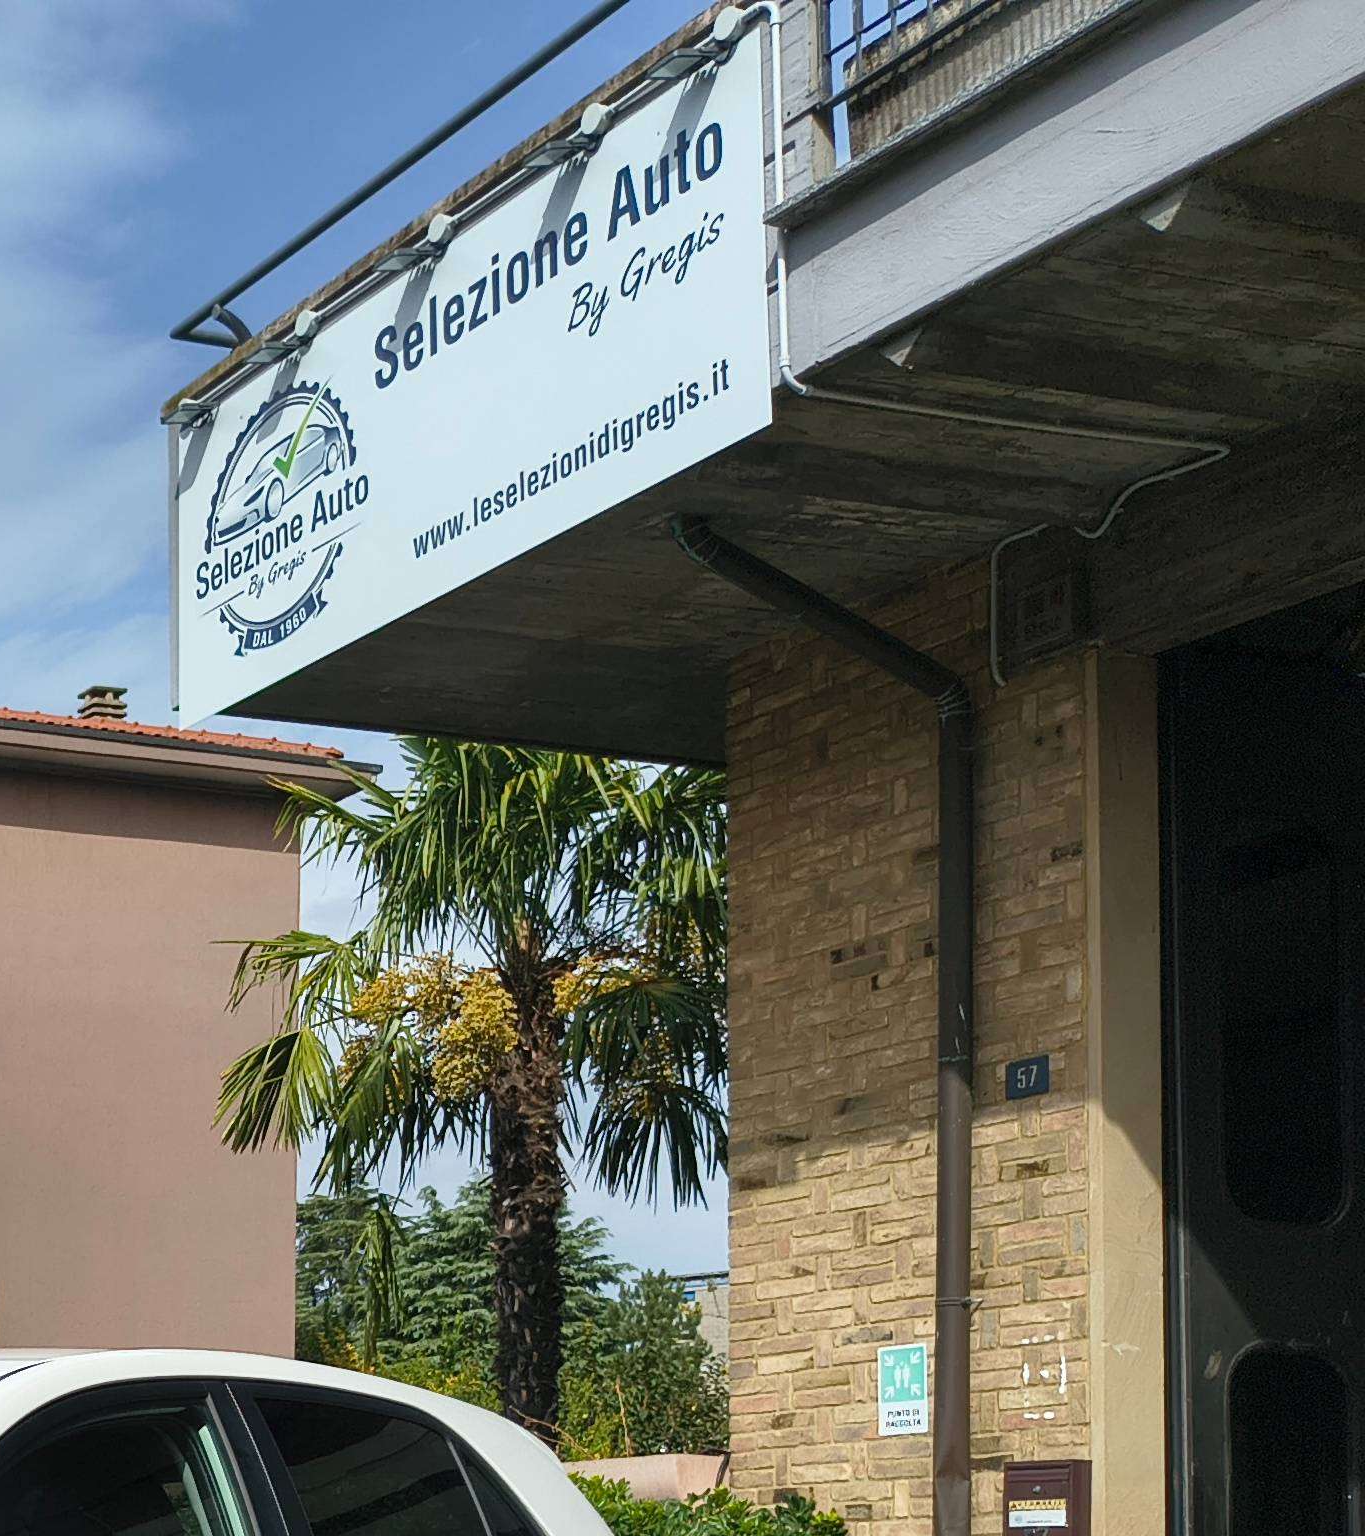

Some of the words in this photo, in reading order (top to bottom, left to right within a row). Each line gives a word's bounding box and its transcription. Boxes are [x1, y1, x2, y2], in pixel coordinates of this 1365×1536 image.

[374, 211, 589, 390] Selezione
[607, 122, 724, 242] Auto
[567, 282, 610, 337] By
[620, 212, 725, 301] Gregis
[412, 358, 730, 558] www.leselezionidigregis.it
[196, 514, 303, 600] Selezione
[310, 475, 369, 532] Auto
[248, 573, 265, 599] By
[267, 551, 307, 585] Gregis
[252, 631, 274, 648] DAL
[279, 607, 307, 639] 1960
[1017, 1065, 1038, 1089] 57
